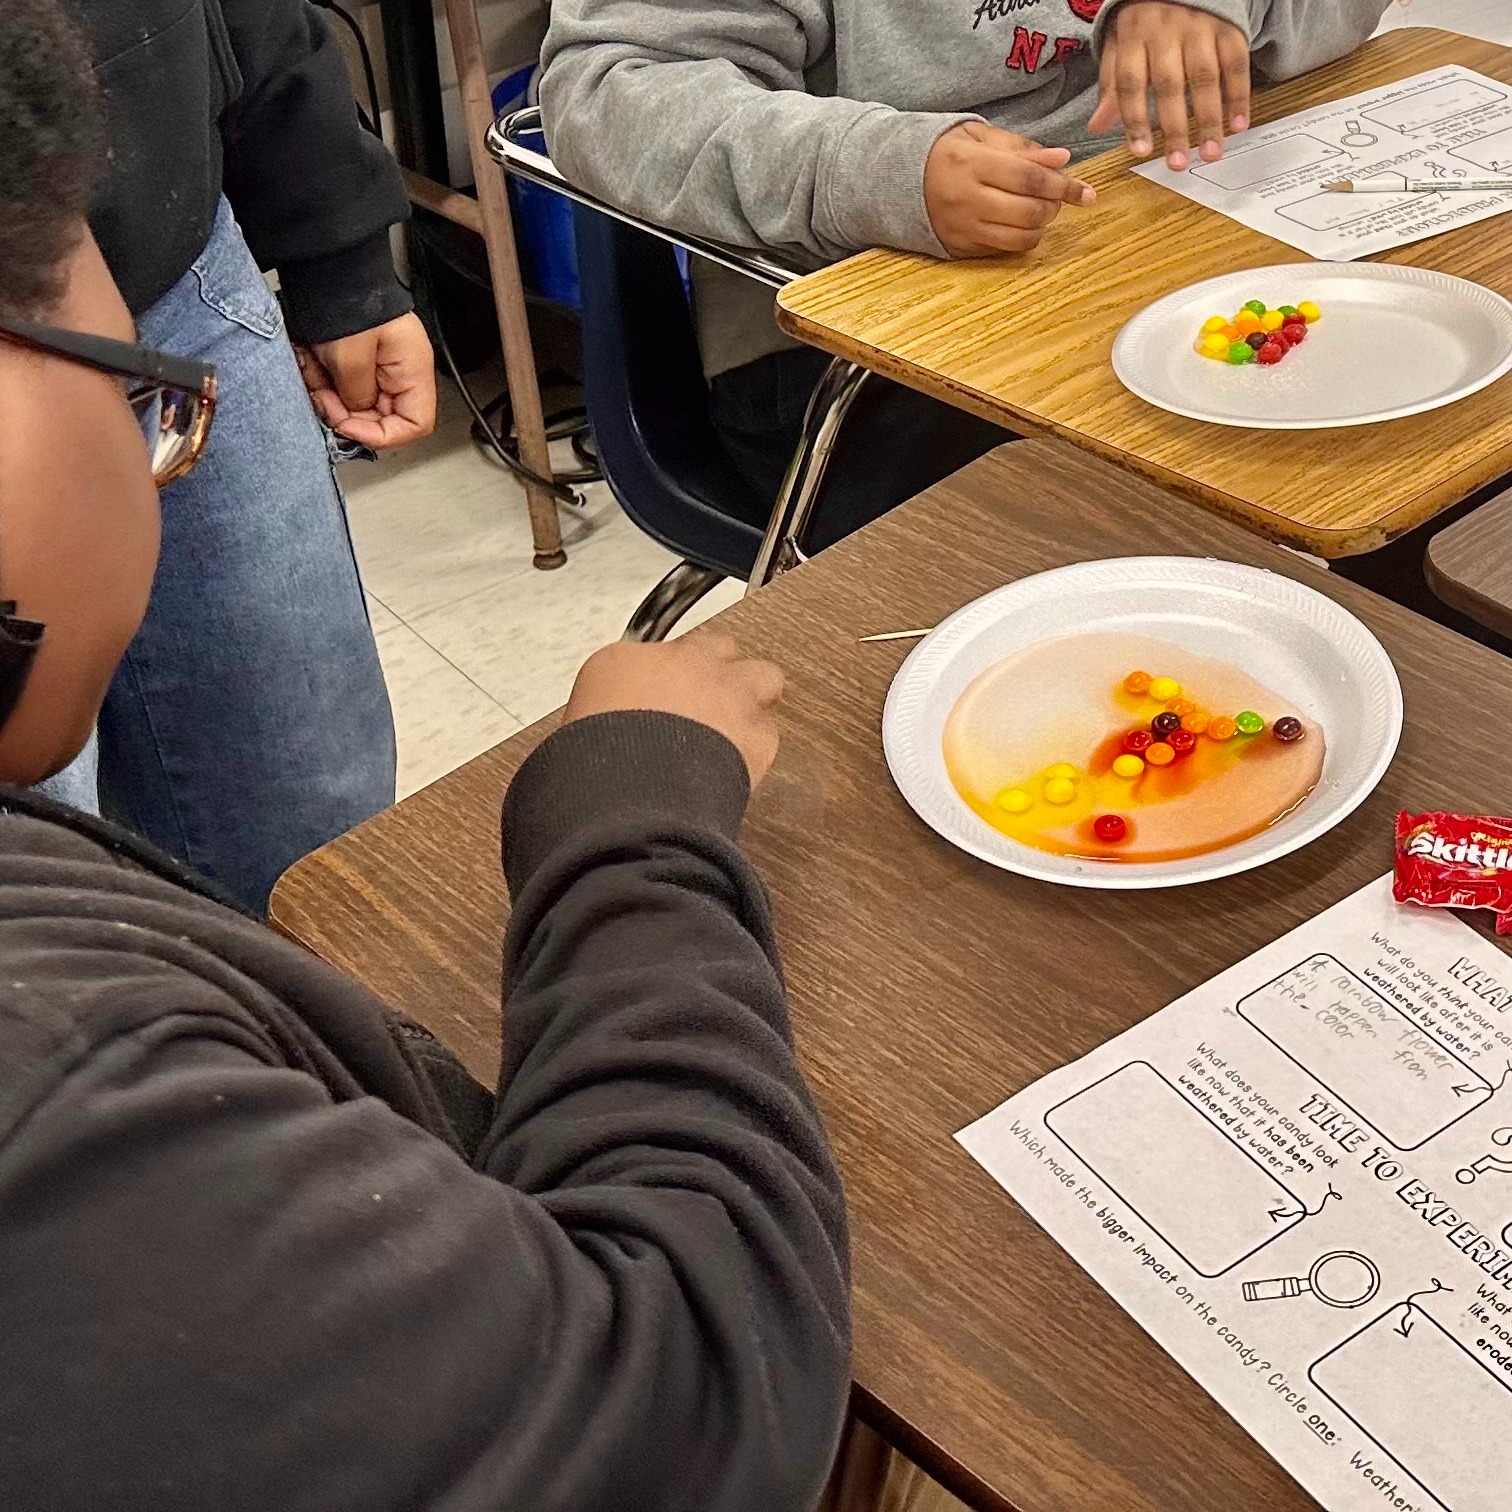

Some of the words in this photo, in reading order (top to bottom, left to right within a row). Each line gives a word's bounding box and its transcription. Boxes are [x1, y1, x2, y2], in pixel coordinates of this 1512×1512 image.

[1179, 1075, 1237, 1126] weathered
[1233, 1123, 1250, 1139] by
[1249, 1139, 1294, 1175] water?
[1196, 1042, 1227, 1069] What
[1225, 1070, 1252, 1092] does
[1249, 1092, 1279, 1116] your
[1278, 1117, 1313, 1147] candy
[1312, 1145, 1339, 1168] look
[1298, 1093, 1370, 1153] TIME
[1362, 1147, 1404, 1181] TO
[1010, 1120, 1046, 1159] Which
[1043, 1157, 1076, 1188] made
[1075, 1187, 1096, 1208] the
[1096, 1207, 1135, 1243] bigger
[1133, 1243, 1178, 1284] impact
[1176, 1287, 1194, 1304] on
[1193, 1302, 1217, 1325] the
[1216, 1326, 1271, 1373] candy?
[1268, 1372, 1307, 1414] Circle
[1309, 1414, 1342, 1445] one:
